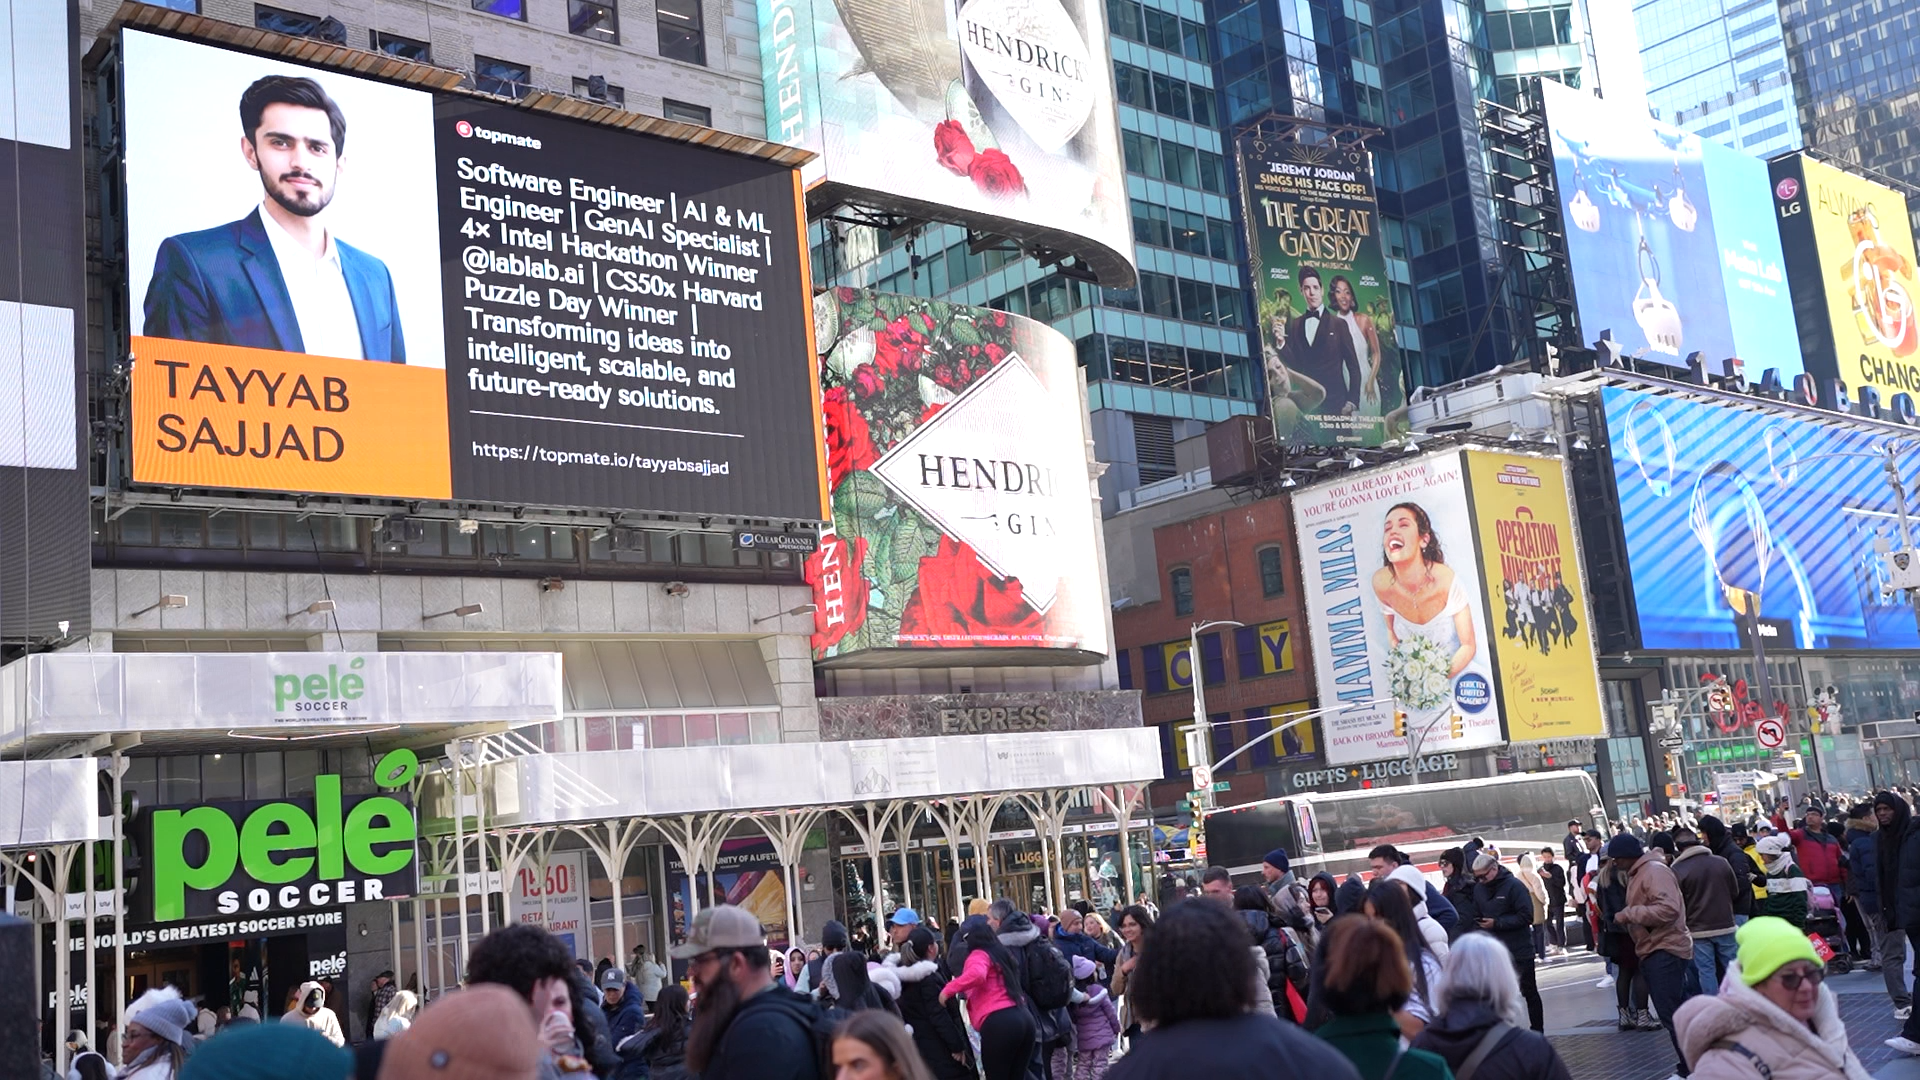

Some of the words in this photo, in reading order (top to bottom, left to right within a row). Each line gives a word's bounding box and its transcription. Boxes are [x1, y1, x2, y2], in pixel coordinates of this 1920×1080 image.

[966, 19, 1087, 83] HENDRICK
[770, 0, 804, 147] HEND
[1019, 76, 1063, 103] GIN
[474, 126, 541, 149] topmate
[1260, 173, 1293, 186] SINGS
[1295, 178, 1312, 188] HIS
[1315, 180, 1340, 191] FACE
[1342, 183, 1366, 194] OFF!
[1313, 168, 1356, 181] JORDAN
[457, 157, 562, 195] Software
[569, 178, 665, 214] Engineer
[683, 200, 707, 222] AI
[715, 205, 731, 227] &
[737, 209, 771, 234] ML
[1780, 201, 1801, 218] LG
[460, 187, 564, 224] Engineer
[584, 209, 654, 240] GenAI
[661, 222, 761, 257] Specialist
[1264, 200, 1300, 229] THE
[1303, 206, 1370, 236] GREAT
[501, 222, 553, 251] Intel
[561, 233, 678, 271] Hackathon
[683, 252, 758, 284] Winner
[1279, 230, 1362, 261] GATSBY
[462, 246, 584, 284] @lablab.ai
[605, 268, 677, 298] CS50x
[683, 280, 762, 311] Harvard
[1723, 248, 1758, 276] Meta
[1758, 258, 1782, 282] Lab
[465, 276, 541, 307] Puzzle
[548, 288, 592, 320] Day
[597, 295, 678, 326] Winner
[464, 306, 620, 352] Transforming
[628, 328, 684, 354] ideas
[690, 336, 731, 360] into
[467, 337, 591, 375] intelligent,
[599, 357, 691, 386] scalable,
[698, 368, 736, 388] and
[154, 359, 350, 413] TAYYAB
[467, 368, 612, 409] future-ready
[618, 386, 720, 414] solutions.
[157, 413, 345, 463] SAJJAD
[472, 441, 729, 475] https://topmate.io/tayyabsajjad
[1303, 502, 1336, 518] YOU'RE
[1338, 493, 1374, 509] GONNA
[1376, 484, 1400, 502] LOVE
[1423, 470, 1459, 487] AGAIN!
[1328, 486, 1348, 499] YOU
[1350, 474, 1395, 494] ALREADY
[1397, 464, 1427, 481] KNOW
[1496, 519, 1560, 559] OPERATION
[1315, 523, 1360, 595] MIA!
[1261, 631, 1289, 670] Y
[1325, 596, 1377, 716] MAMMA
[274, 656, 365, 712] pelé
[1460, 689, 1485, 697] LIMITED
[295, 701, 348, 712] SOCCER
[940, 705, 1051, 733] EXPRESS
[1332, 736, 1352, 746] BACK
[1353, 735, 1364, 743] ON
[1365, 729, 1395, 742] BROADW
[1292, 767, 1347, 788] GIFTS
[1361, 753, 1458, 781] LUGGAGE
[153, 748, 419, 922] pelé
[739, 854, 748, 863] OF
[217, 879, 384, 914] SOCCER
[159, 921, 237, 942] GREATEST
[239, 918, 296, 933] SOCCER
[297, 911, 343, 928] STORE
[310, 951, 347, 976] pelé
